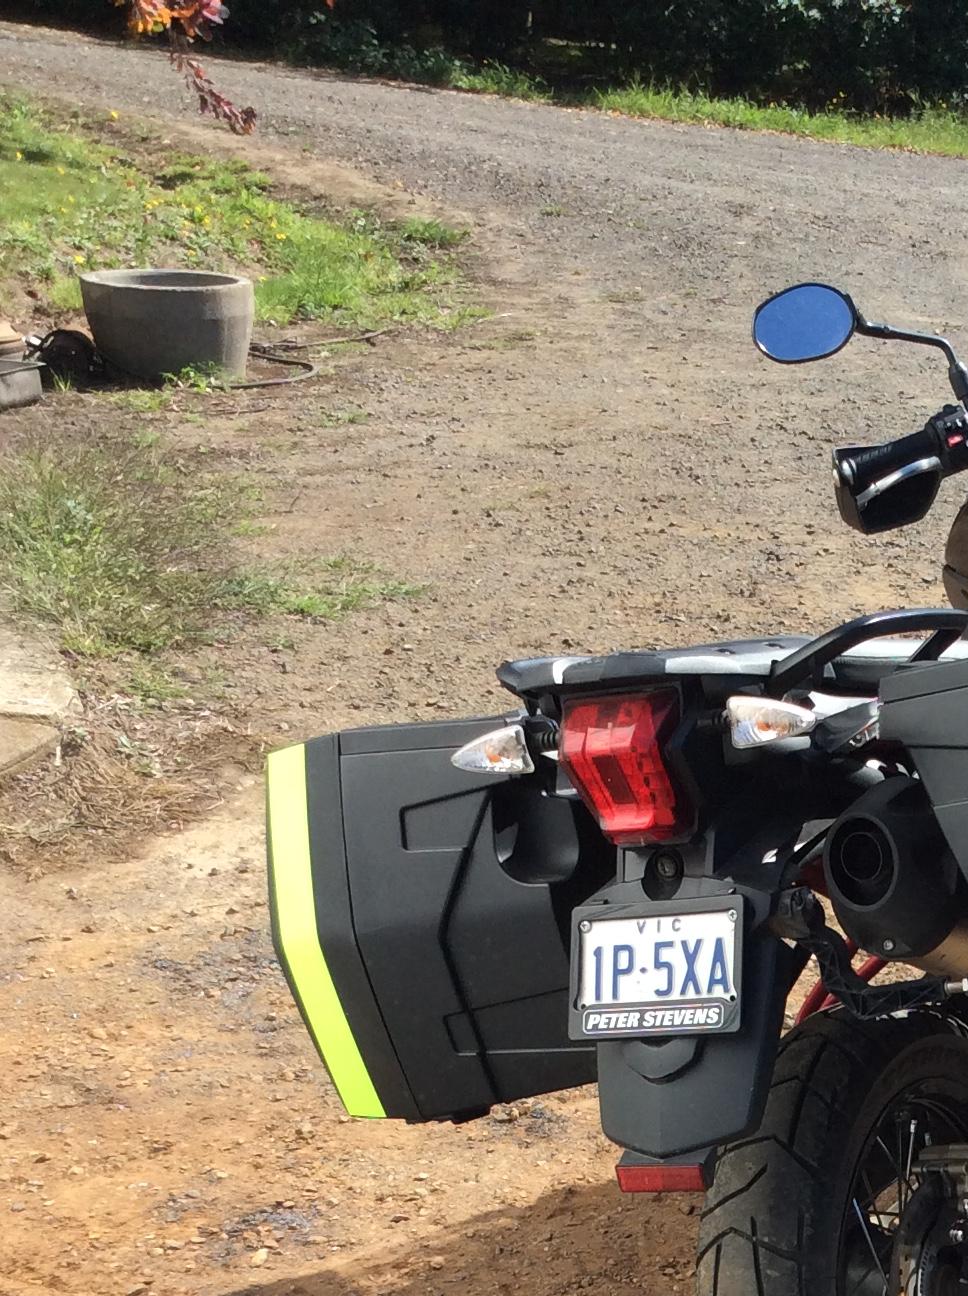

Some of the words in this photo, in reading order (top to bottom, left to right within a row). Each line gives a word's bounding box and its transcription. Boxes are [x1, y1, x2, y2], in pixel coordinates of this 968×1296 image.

[636, 918, 682, 935] VIC
[586, 1012, 641, 1030] PETER
[642, 1007, 721, 1028] STEVENS
